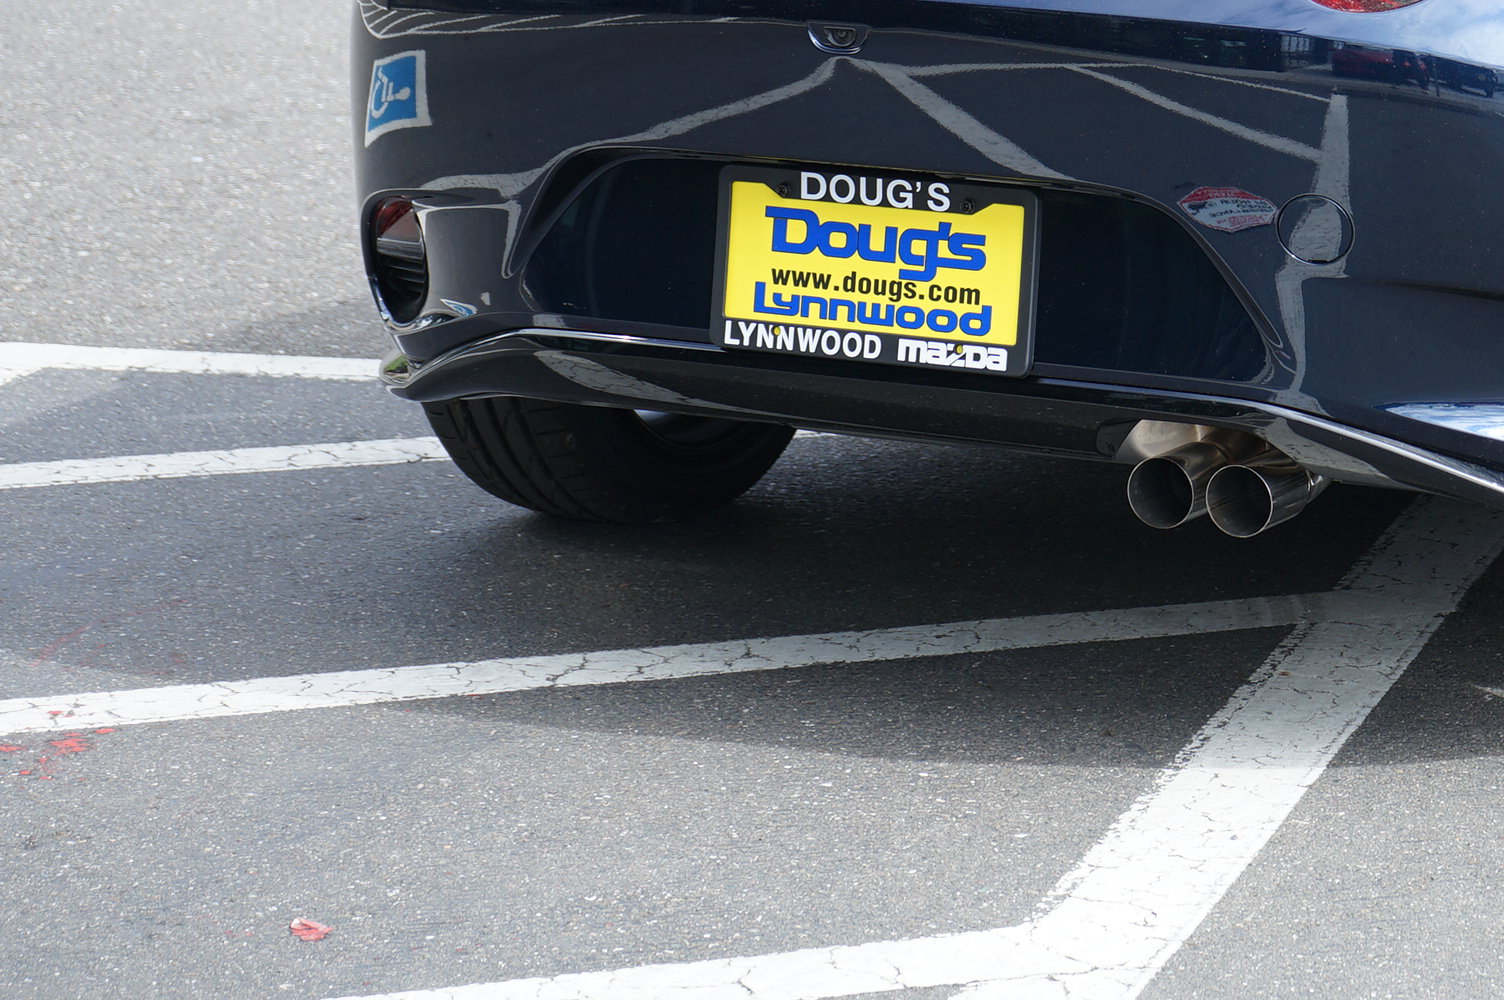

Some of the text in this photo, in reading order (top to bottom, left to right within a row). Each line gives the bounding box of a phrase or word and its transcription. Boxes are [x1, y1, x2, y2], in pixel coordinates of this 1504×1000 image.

[800, 171, 951, 213] DOUG'S
[770, 267, 982, 306] www.dougs.com
[753, 280, 993, 337] Lynnwood
[723, 319, 883, 360] LYNNWOOD
